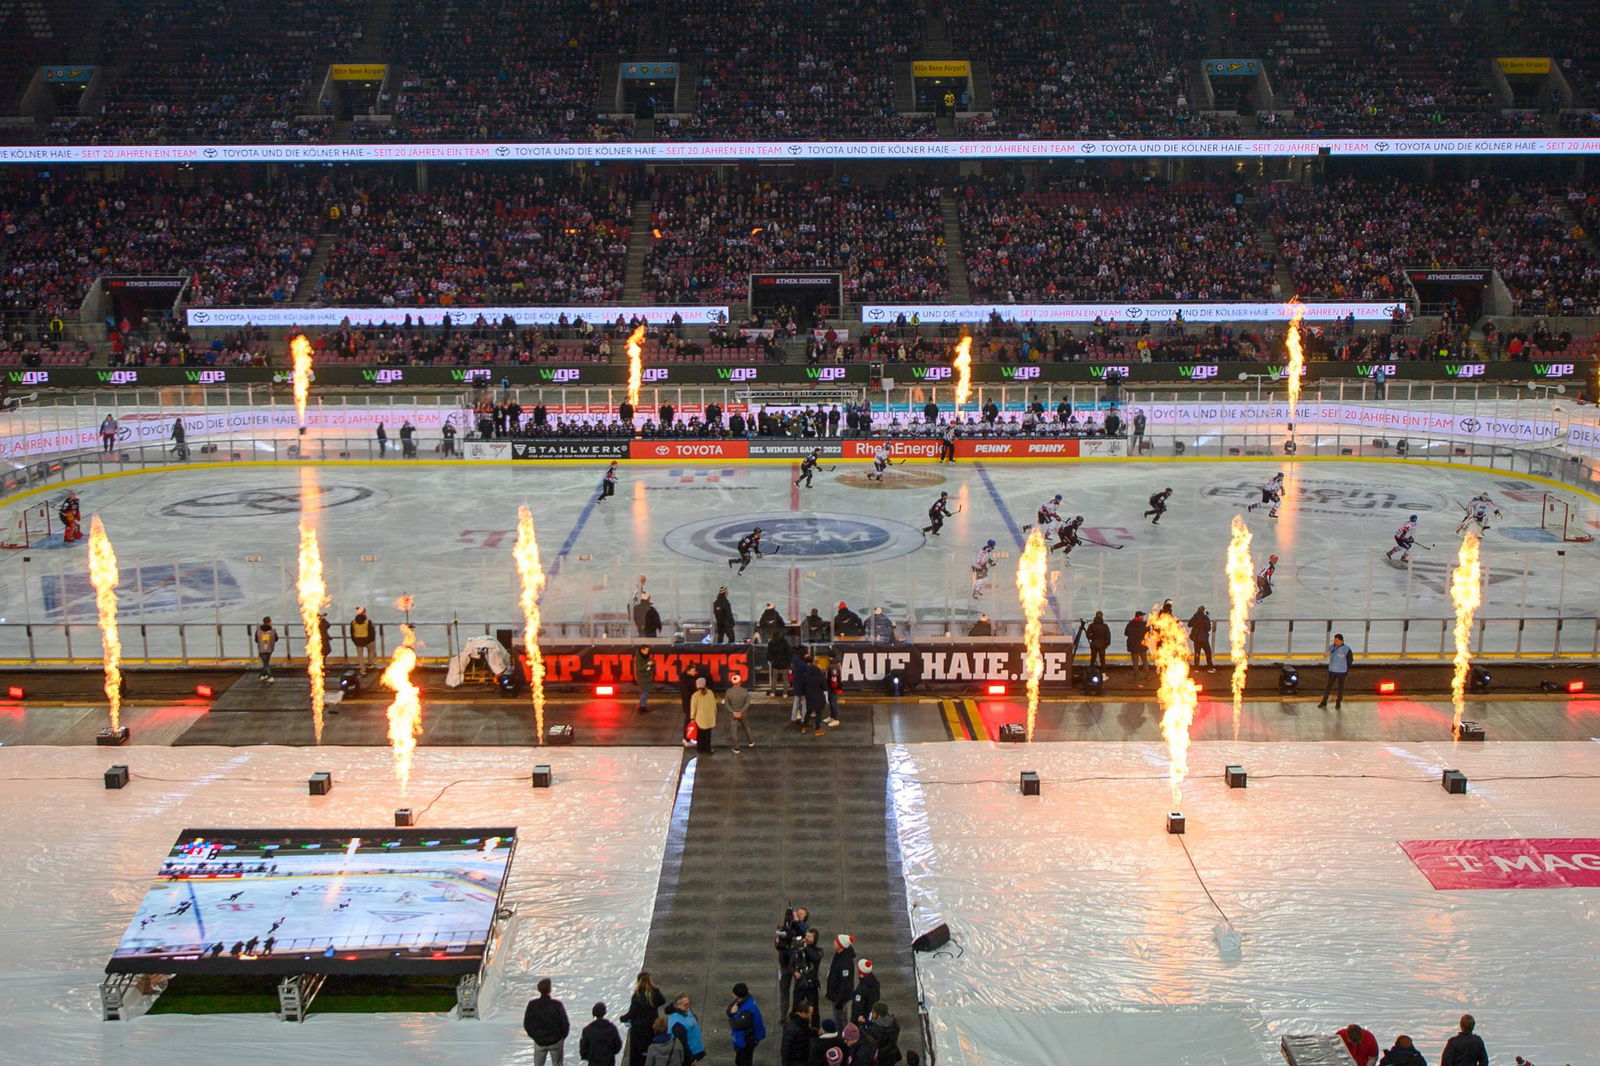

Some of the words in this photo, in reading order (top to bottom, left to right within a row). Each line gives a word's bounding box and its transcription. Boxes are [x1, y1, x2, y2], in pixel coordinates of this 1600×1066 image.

[596, 146, 632, 155] KÖLNER
[888, 145, 925, 154] KÖLNER
[1182, 143, 1218, 152] KÖLNER
[1475, 142, 1512, 151] KÖLNER
[11, 149, 48, 158] KÖLNER
[304, 148, 340, 157] KÖLNER
[642, 368, 668, 381] ige
[208, 418, 224, 428] DIE
[227, 415, 269, 426] KÖLNER
[333, 416, 344, 424] 20
[348, 415, 388, 424] JAHREN
[412, 414, 440, 424] TEAM
[1240, 408, 1282, 418] KÖLNER
[1345, 411, 1357, 419] 20
[1359, 411, 1400, 424] JAHREN
[1403, 416, 1420, 425] EIN
[1423, 418, 1453, 428] TEAM
[1486, 422, 1532, 435] TOYOTA
[1573, 430, 1590, 441] DIE
[676, 445, 723, 455] TOYOTA
[975, 445, 1013, 454] PENNY.
[1029, 445, 1066, 454] PENNY.
[518, 652, 748, 682] VIP-TIKETS
[841, 652, 910, 681] AUF
